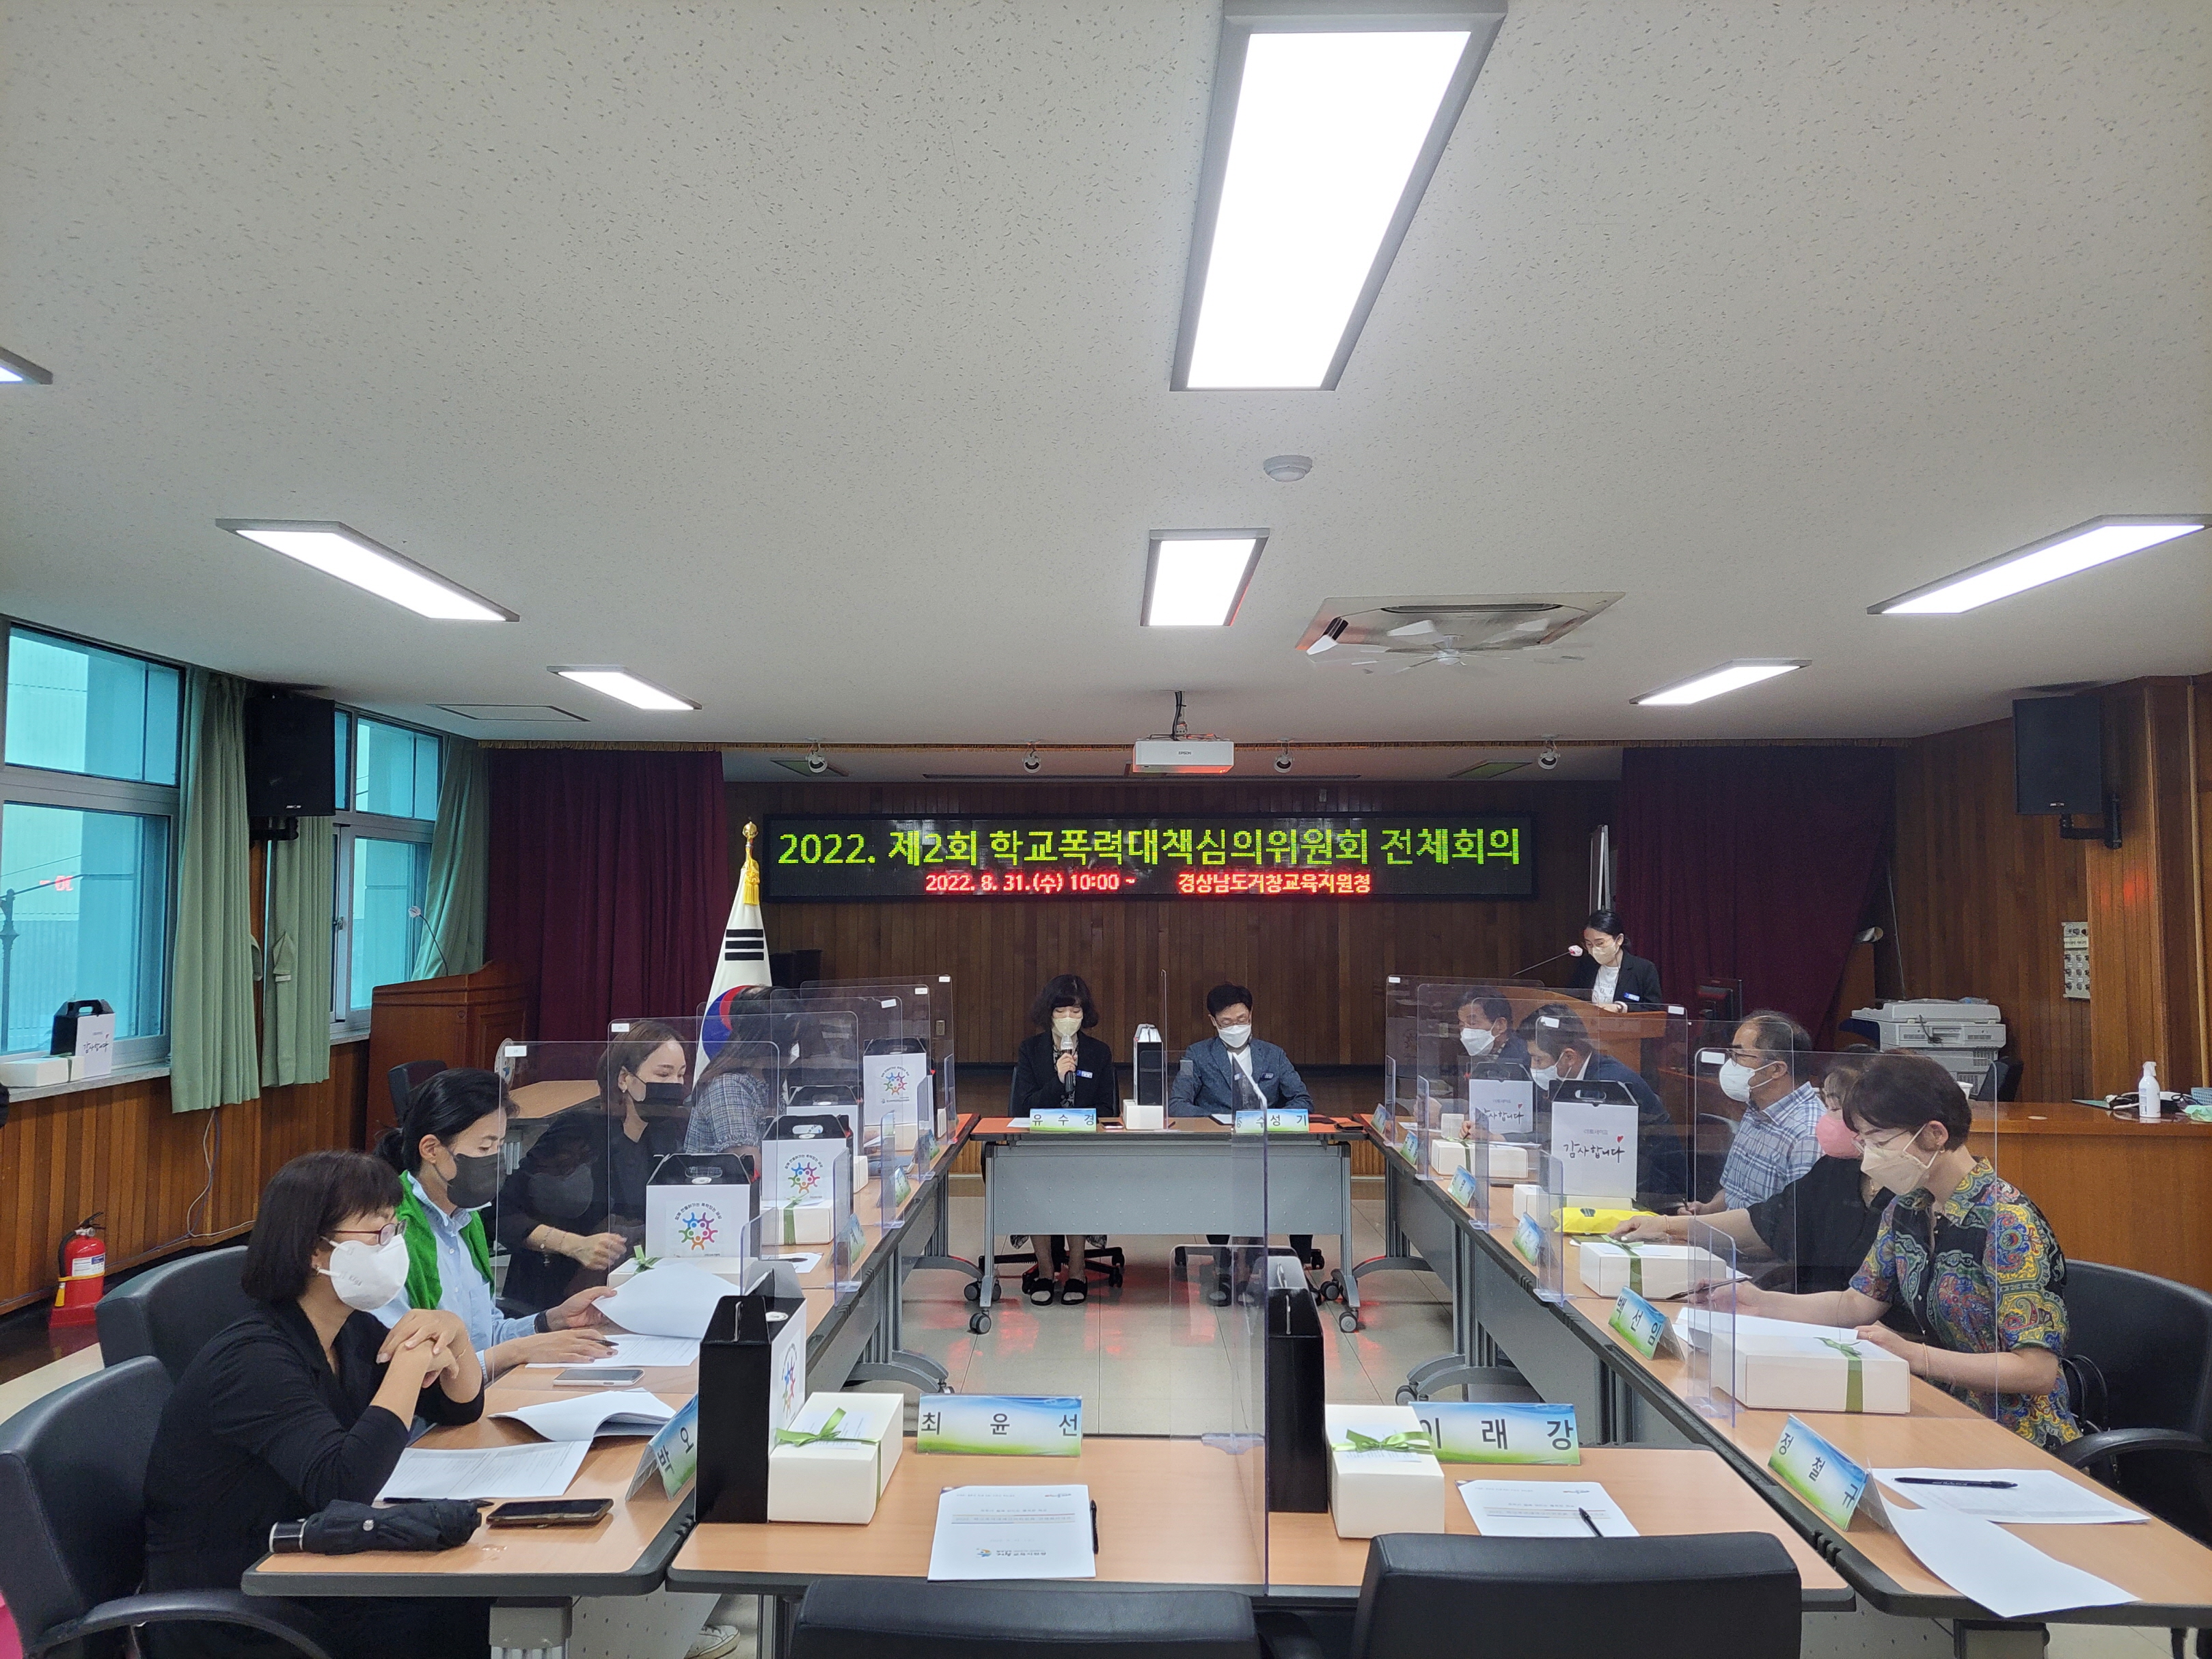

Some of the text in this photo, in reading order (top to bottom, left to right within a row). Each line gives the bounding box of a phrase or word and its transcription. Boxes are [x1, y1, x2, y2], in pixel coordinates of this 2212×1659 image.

[778, 828, 1520, 866] 2022. 제2회 학교폭력대책심의위원회 전체회의
[925, 874, 975, 892] 2022.
[1069, 873, 1120, 891] 10:00
[1177, 872, 1371, 894] 경상남도거창교육지원청
[1564, 1140, 1626, 1164] 감사합니다
